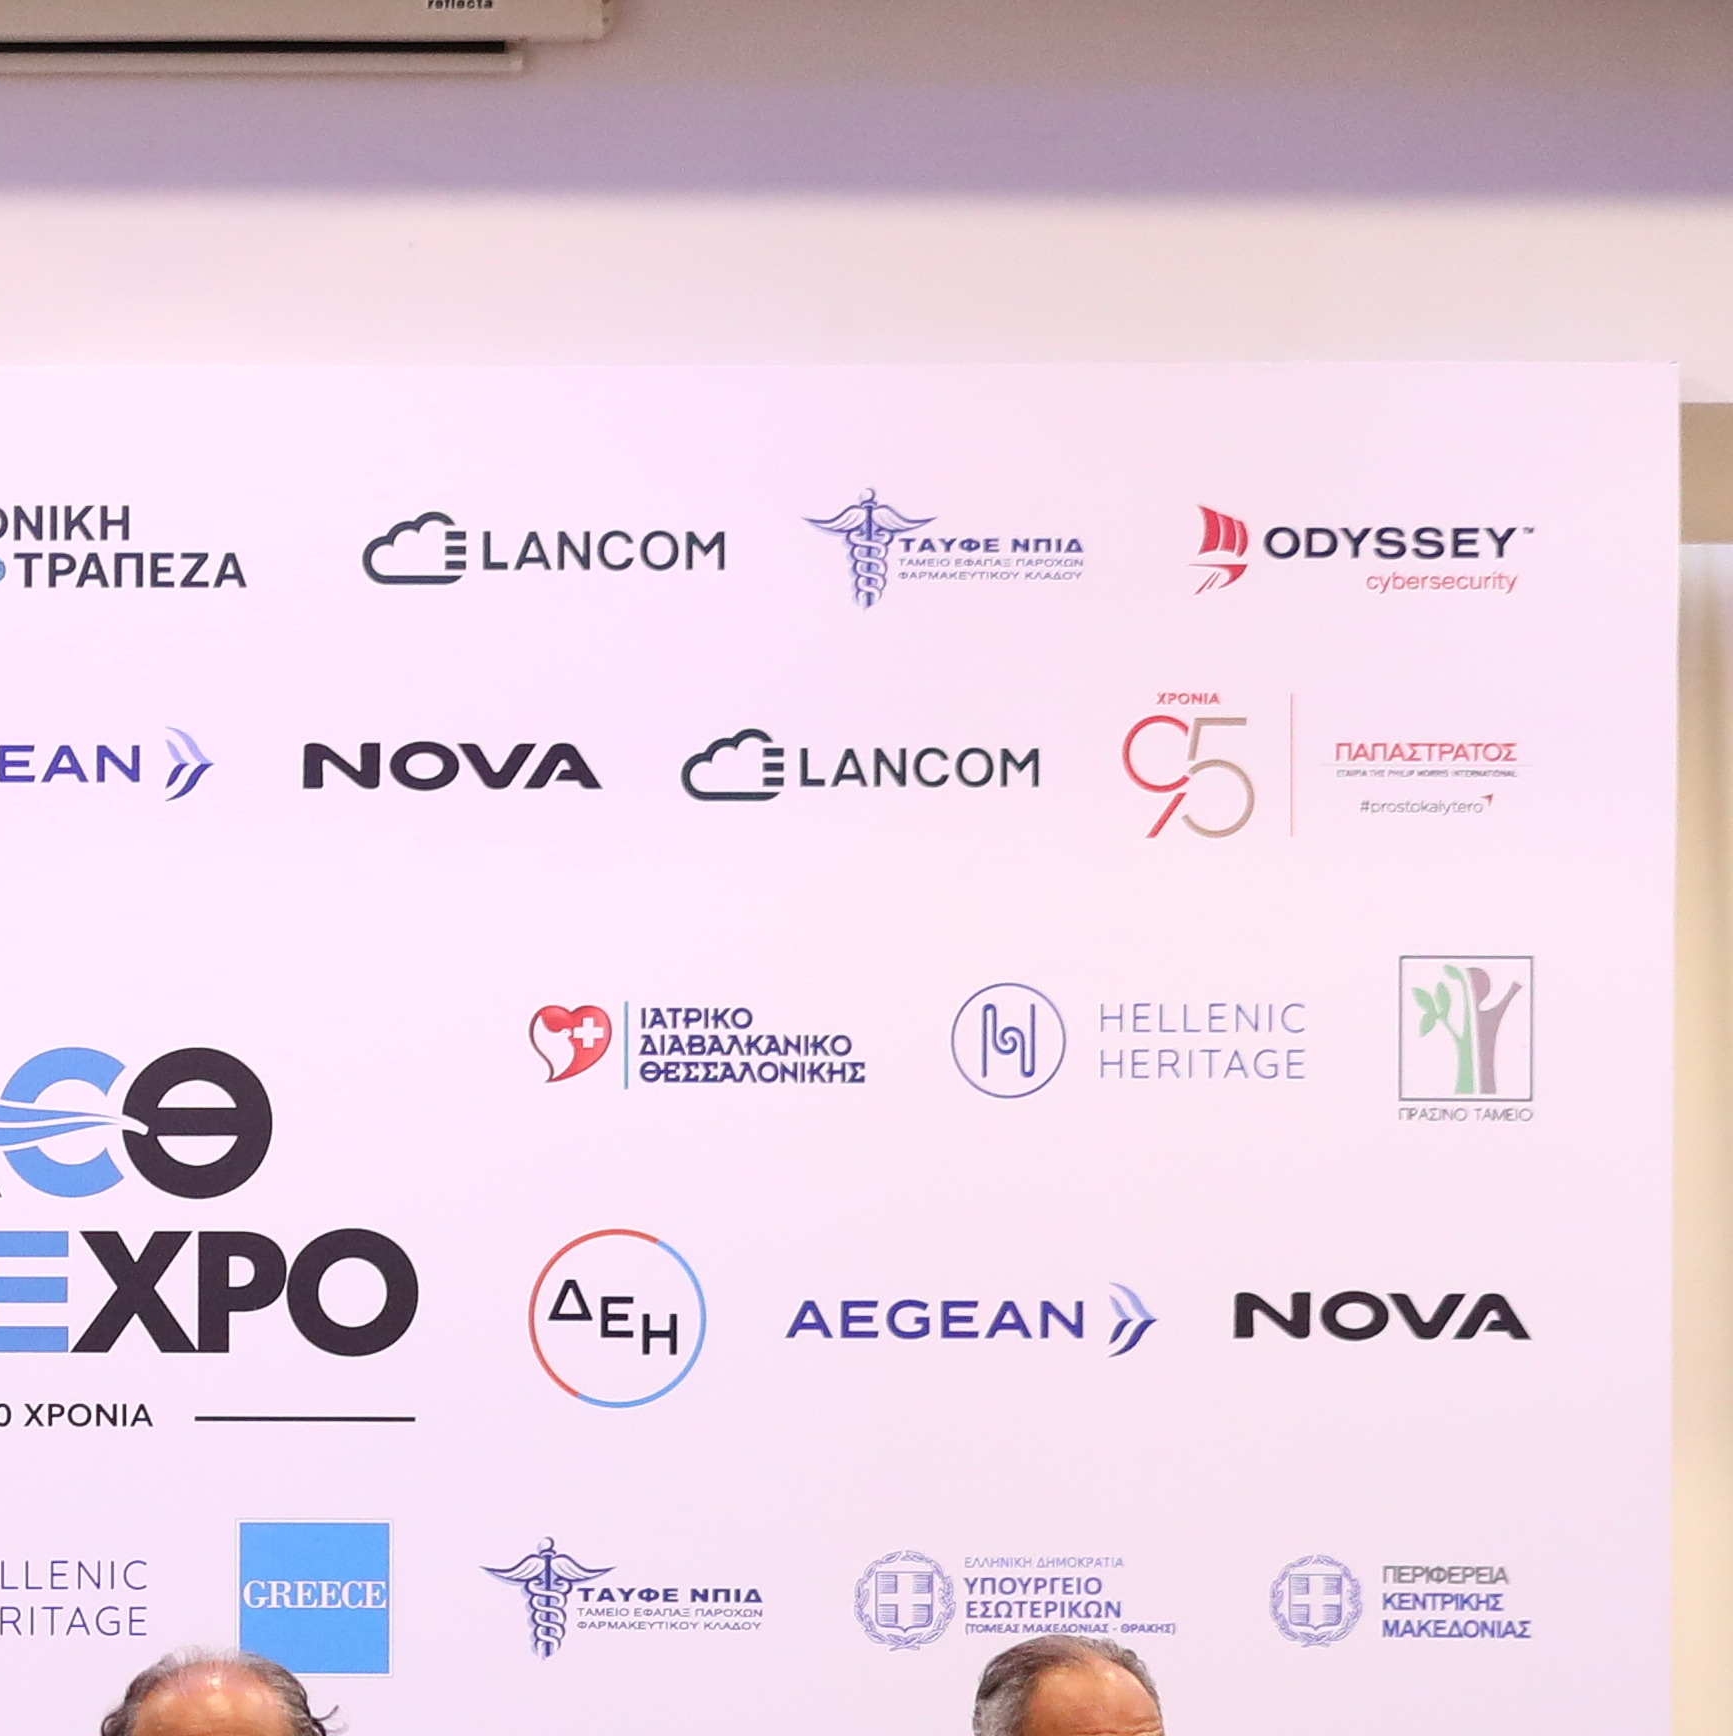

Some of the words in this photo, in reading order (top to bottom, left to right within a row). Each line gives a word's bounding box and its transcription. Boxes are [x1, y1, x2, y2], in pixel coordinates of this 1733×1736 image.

[482, 529, 725, 572] LANCOM
[898, 537, 1000, 553] ΤΑΥΦΕ
[1011, 538, 1083, 553] ΝΠΙΔ
[13, 552, 247, 588] ΤΡΑΠΕΖΑ
[898, 557, 951, 568] ΤΑΜΕΙΟ
[954, 558, 1011, 568] ΕΦΑΠΑΞ
[1015, 558, 1084, 568] ΠΑΡΟΧΩΝ
[898, 571, 1020, 581] ΦΑΡΜΑΚΕΥΤΙΚΟΥ
[1024, 571, 1083, 581] ΚΛΑΔΟΥ
[1366, 571, 1518, 595] cybersecurity
[1156, 692, 1220, 705] ΧΡΟΝΙΑ
[1335, 742, 1517, 763] ΠΑΠΑΣΤΡΑΤΟΣ
[302, 741, 602, 792] NOVA
[800, 747, 1040, 788] LANCOM
[1122, 714, 1255, 839] 95
[1359, 798, 1485, 816] #prostokalytero
[640, 1007, 753, 1030] ΙΑΤΡΙΚΟ
[1100, 1002, 1305, 1034] HELLENIC
[638, 1034, 853, 1057] ΔΙΑΒΑΛΚΑΝΙΚΟ
[639, 1060, 866, 1084] ΘΕΣΣΑΛΟΝΙΚΗΣ
[1100, 1048, 1305, 1080] HERITAGE
[1398, 1107, 1468, 1122] ΠΡΑΣΙΝΟ
[1473, 1107, 1534, 1122] ΤΑΜΕΙΟ
[547, 1278, 678, 1356] ΔΕΗ
[785, 1299, 1084, 1340] AEGEAN
[1233, 1290, 1531, 1342] NOVA
[24, 1403, 153, 1428] ΧΡΟΝΙΑ
[963, 1576, 1103, 1596] ΥΠΟΥΡΓΕΙΟ
[1382, 1565, 1509, 1585] ΠΕΡΙΦΕΡΕΙΑ
[242, 1580, 388, 1610] GREECE
[577, 1587, 679, 1603] ΤΑΥΦΕ
[690, 1588, 763, 1604] ΝΠΙΔ
[1382, 1592, 1504, 1612] ΚΕΝΤΡΙΚΗΣ
[966, 1600, 1122, 1619] ΕΣΩΤΕΡΙΚΩΝ
[1382, 1619, 1532, 1639] ΜΑΚΕΔΟΝΙΑΣ
